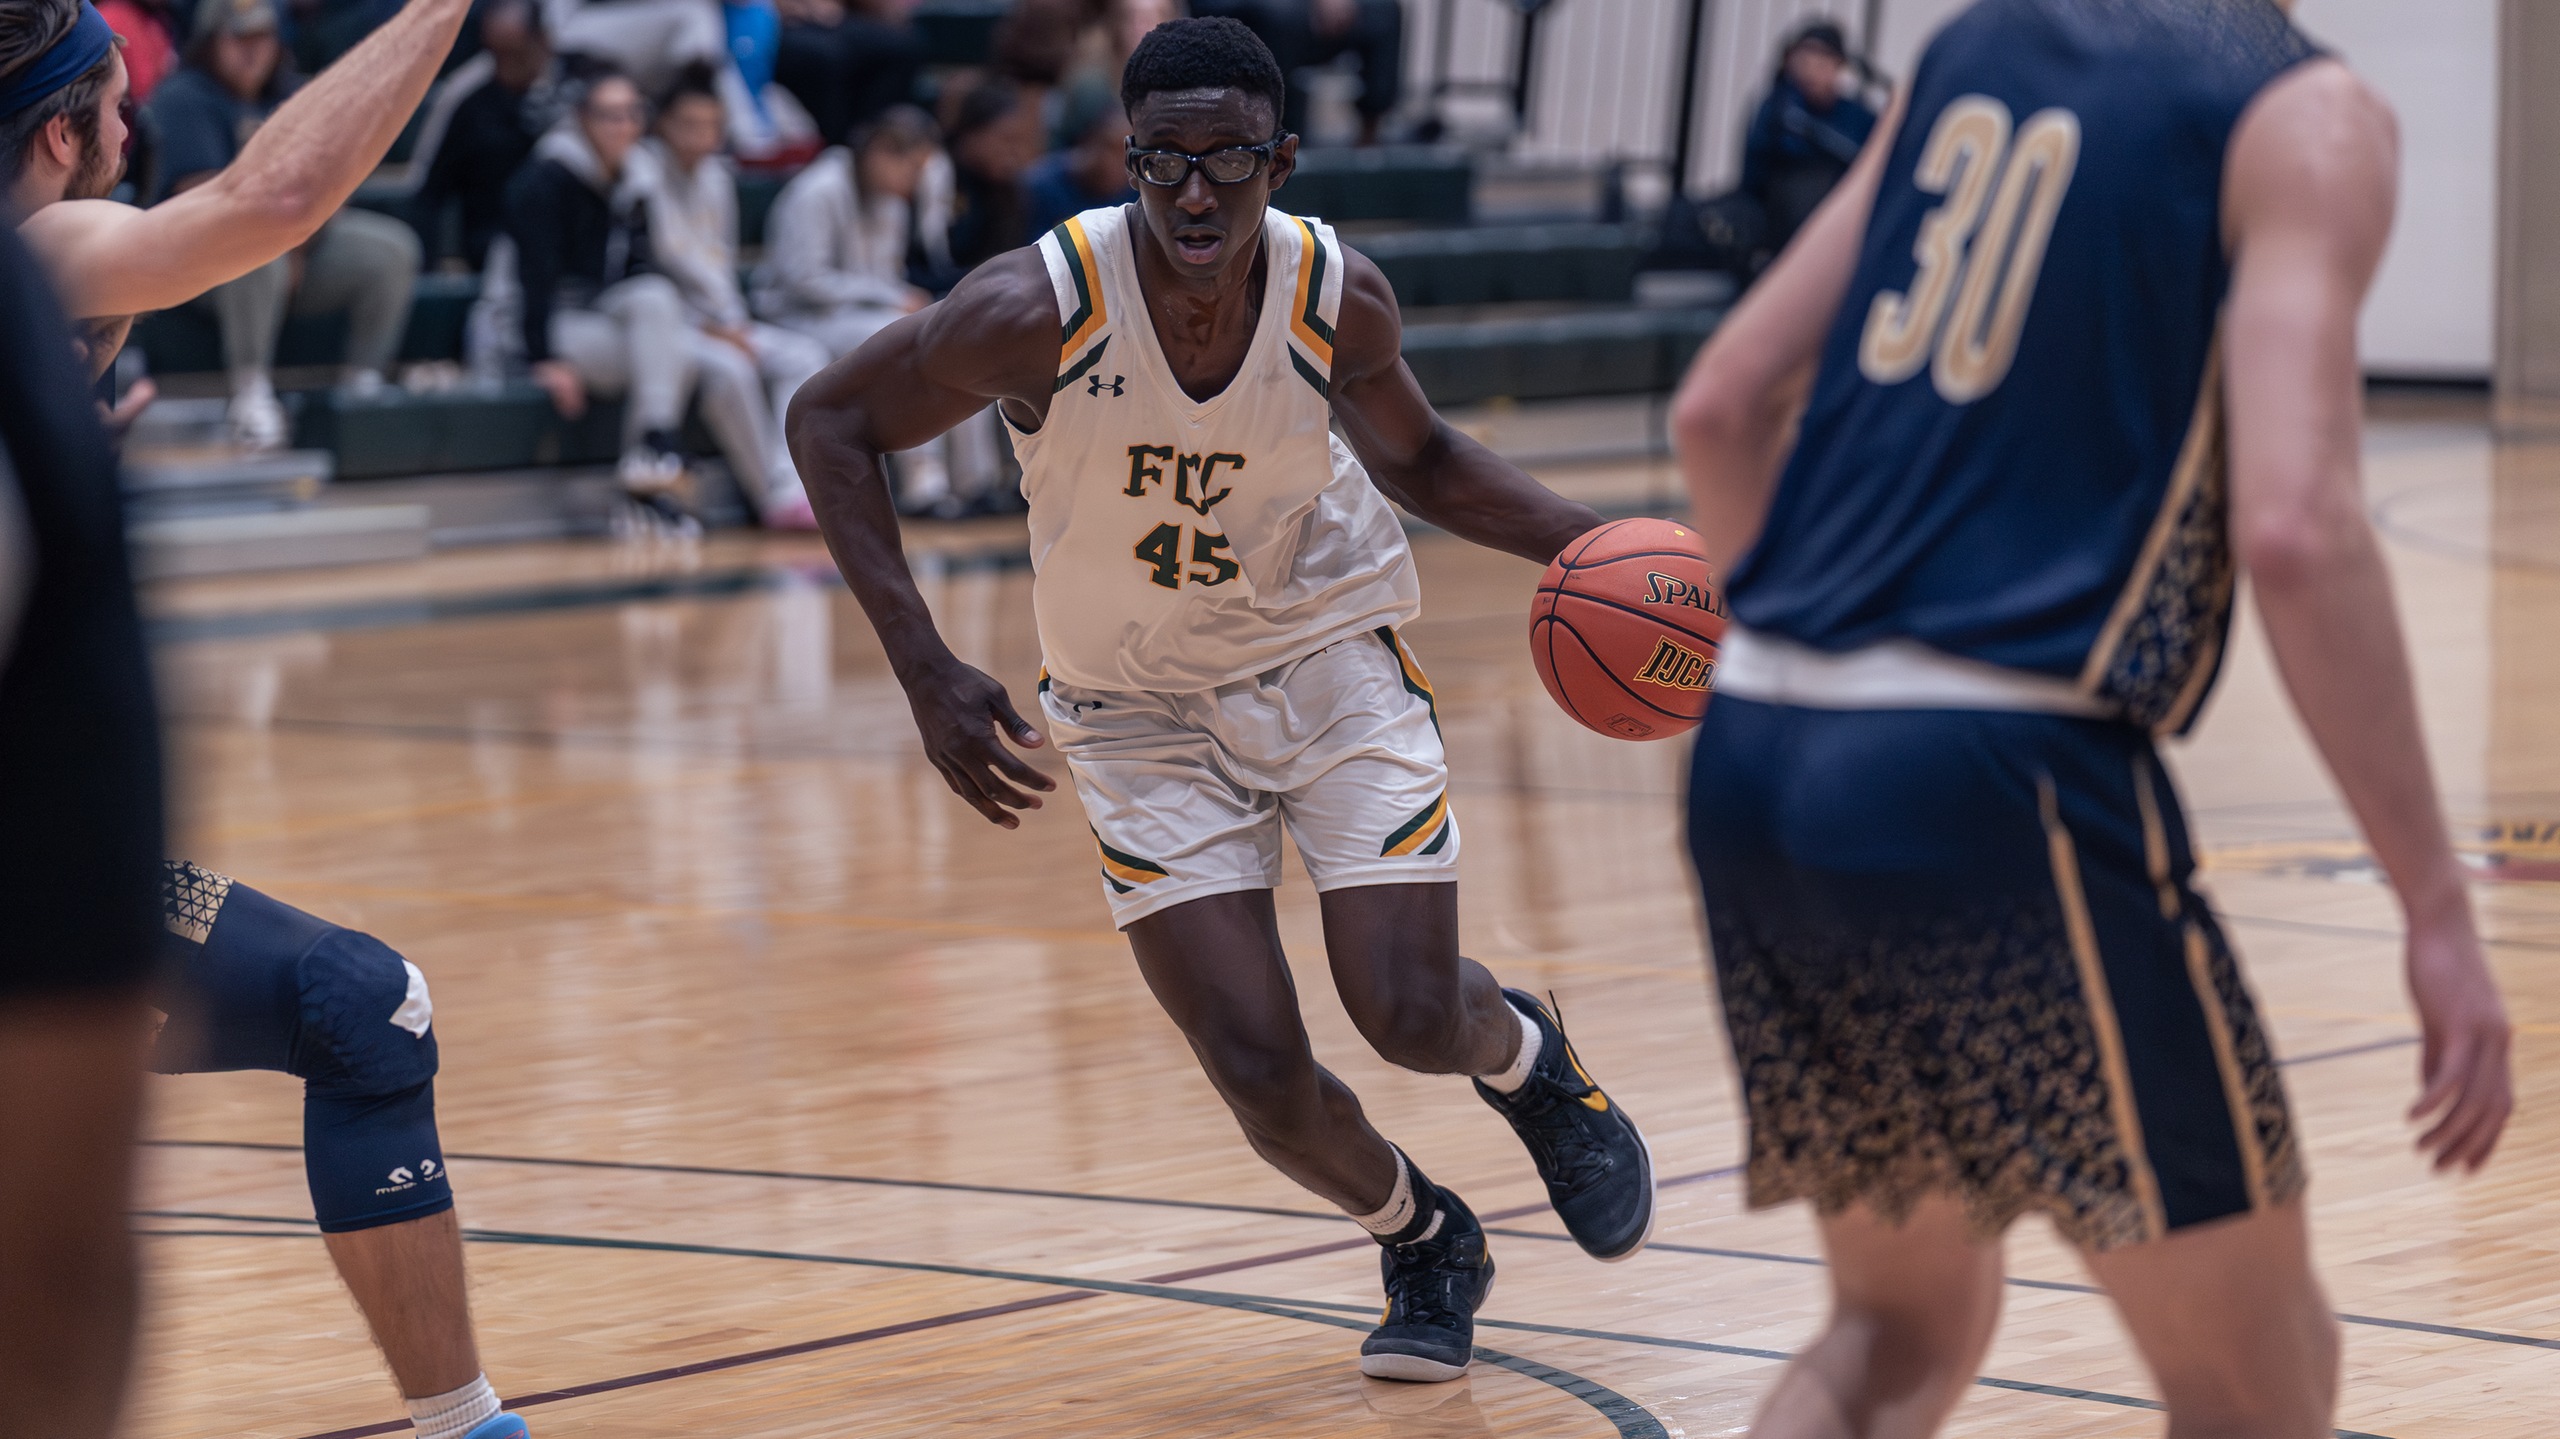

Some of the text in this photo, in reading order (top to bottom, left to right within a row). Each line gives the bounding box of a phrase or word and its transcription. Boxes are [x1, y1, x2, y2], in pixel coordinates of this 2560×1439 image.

[1857, 92, 2083, 406] 30
[1132, 520, 1241, 590] 45
[1634, 635, 1721, 691] NJCA
